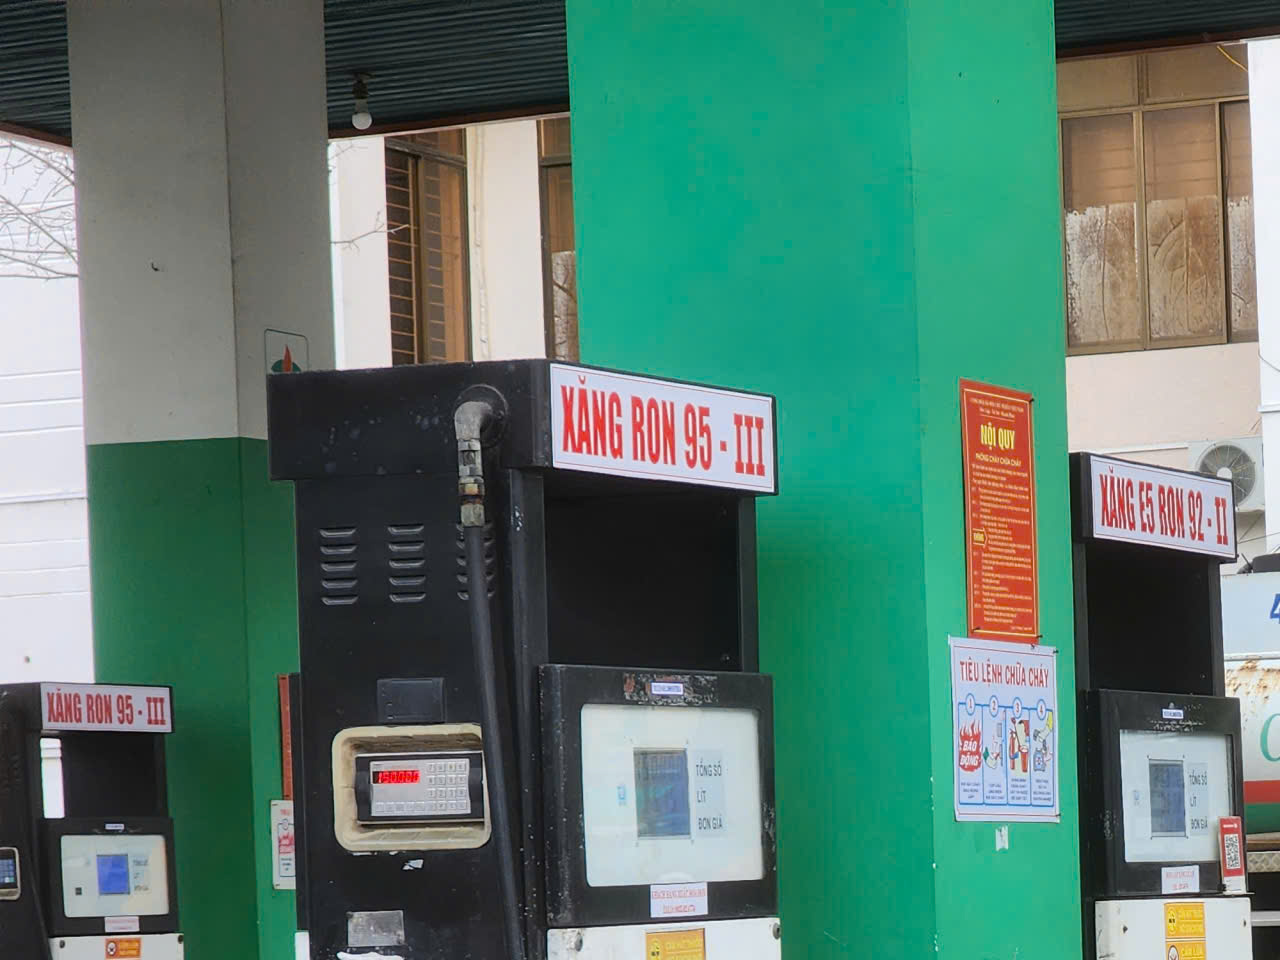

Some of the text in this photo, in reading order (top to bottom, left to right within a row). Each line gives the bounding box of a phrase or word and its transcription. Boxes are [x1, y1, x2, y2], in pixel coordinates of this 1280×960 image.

[560, 375, 623, 459] XĂNG
[631, 396, 676, 465] RON
[684, 403, 712, 470] 95
[733, 413, 765, 476] III
[980, 421, 1015, 451] NỘI QUY
[1099, 466, 1136, 531] XĂNG
[1139, 480, 1155, 535] E5
[1158, 484, 1185, 539] RON
[1188, 489, 1205, 542] 92
[1214, 496, 1229, 546] II
[959, 656, 1049, 688] TIÊU LỆNH CHỮA CHÁY
[47, 688, 82, 723] XĂNG
[86, 693, 113, 724] RON
[117, 695, 134, 725] 95
[146, 697, 166, 725] III
[963, 737, 977, 752] BÁO
